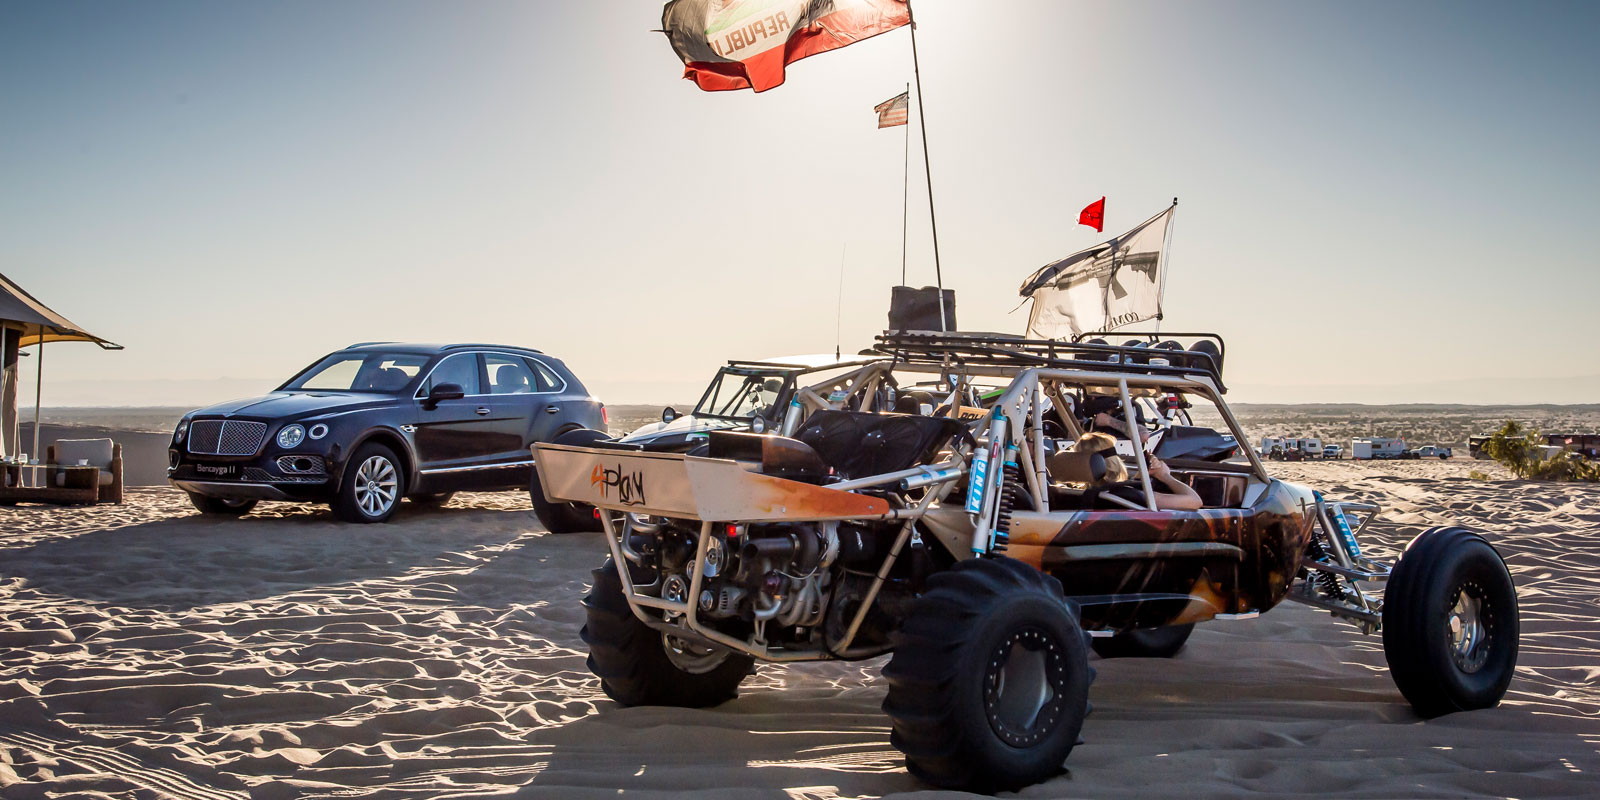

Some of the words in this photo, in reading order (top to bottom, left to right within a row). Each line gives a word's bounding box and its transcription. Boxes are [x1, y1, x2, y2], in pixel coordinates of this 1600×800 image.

[591, 463, 646, 506] 4Play
[972, 461, 986, 509] KING
[1336, 517, 1357, 554] KING
